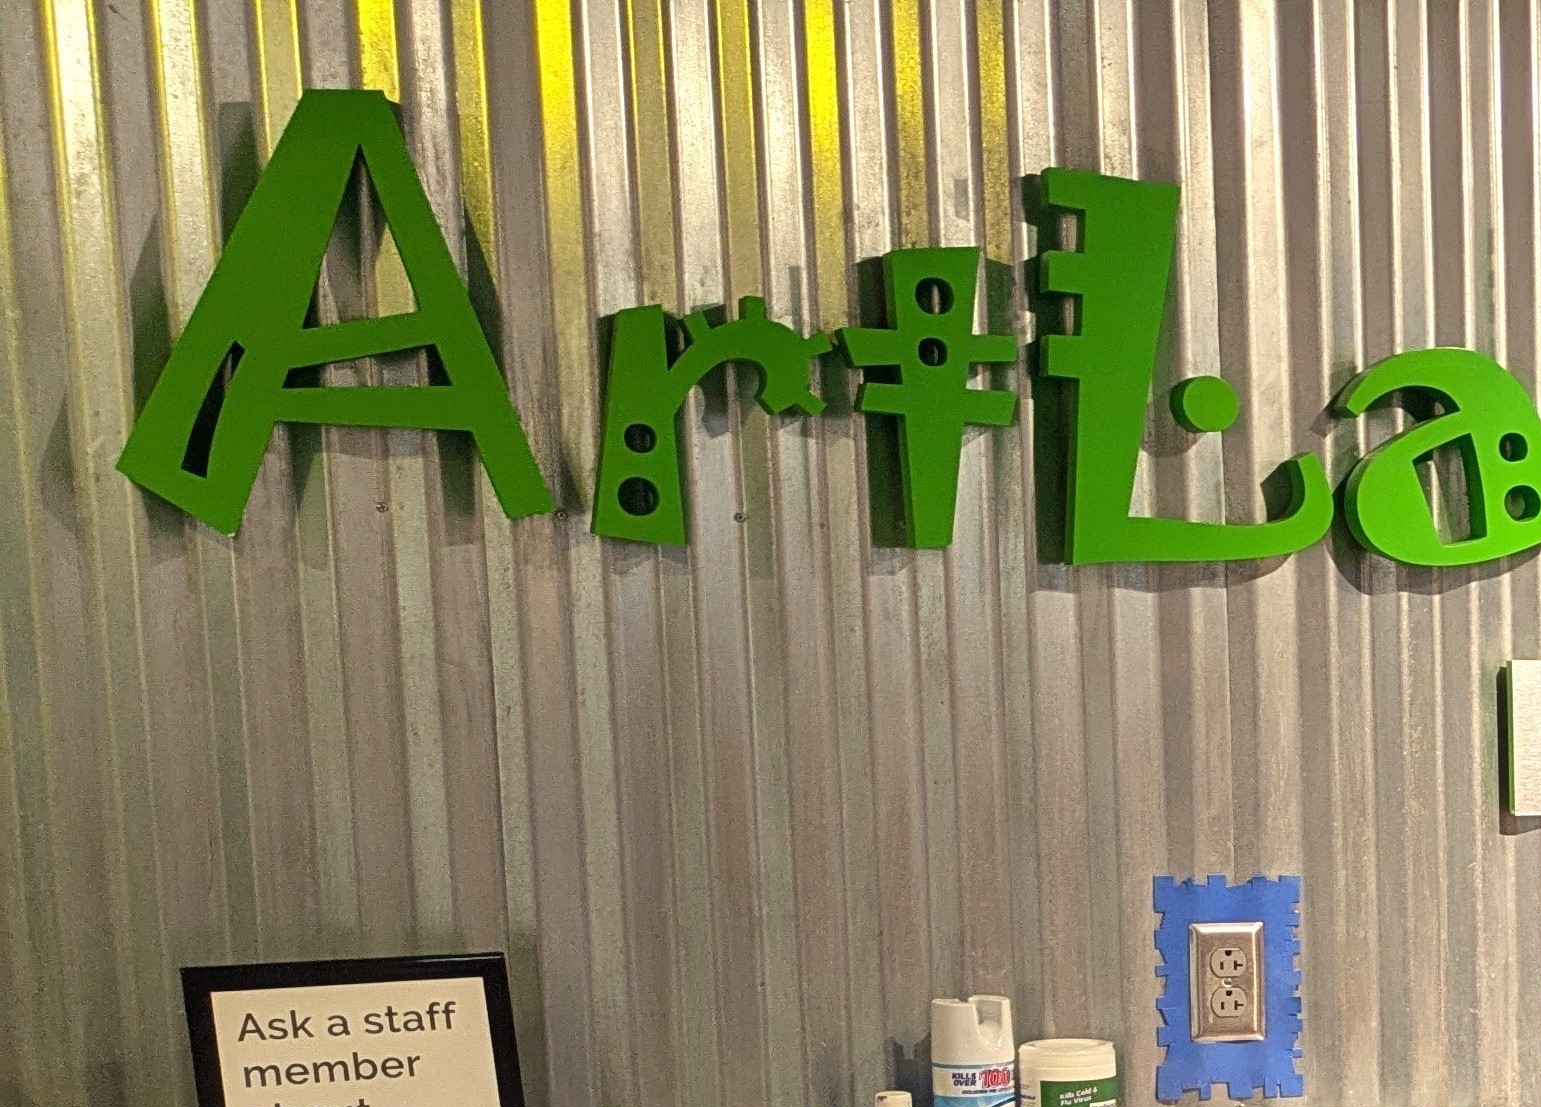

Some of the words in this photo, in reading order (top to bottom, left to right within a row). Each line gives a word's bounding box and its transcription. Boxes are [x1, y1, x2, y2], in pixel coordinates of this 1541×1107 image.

[237, 1009, 315, 1042] Ask
[327, 1013, 351, 1036] a
[364, 1001, 457, 1034] staff
[243, 1051, 421, 1088] member
